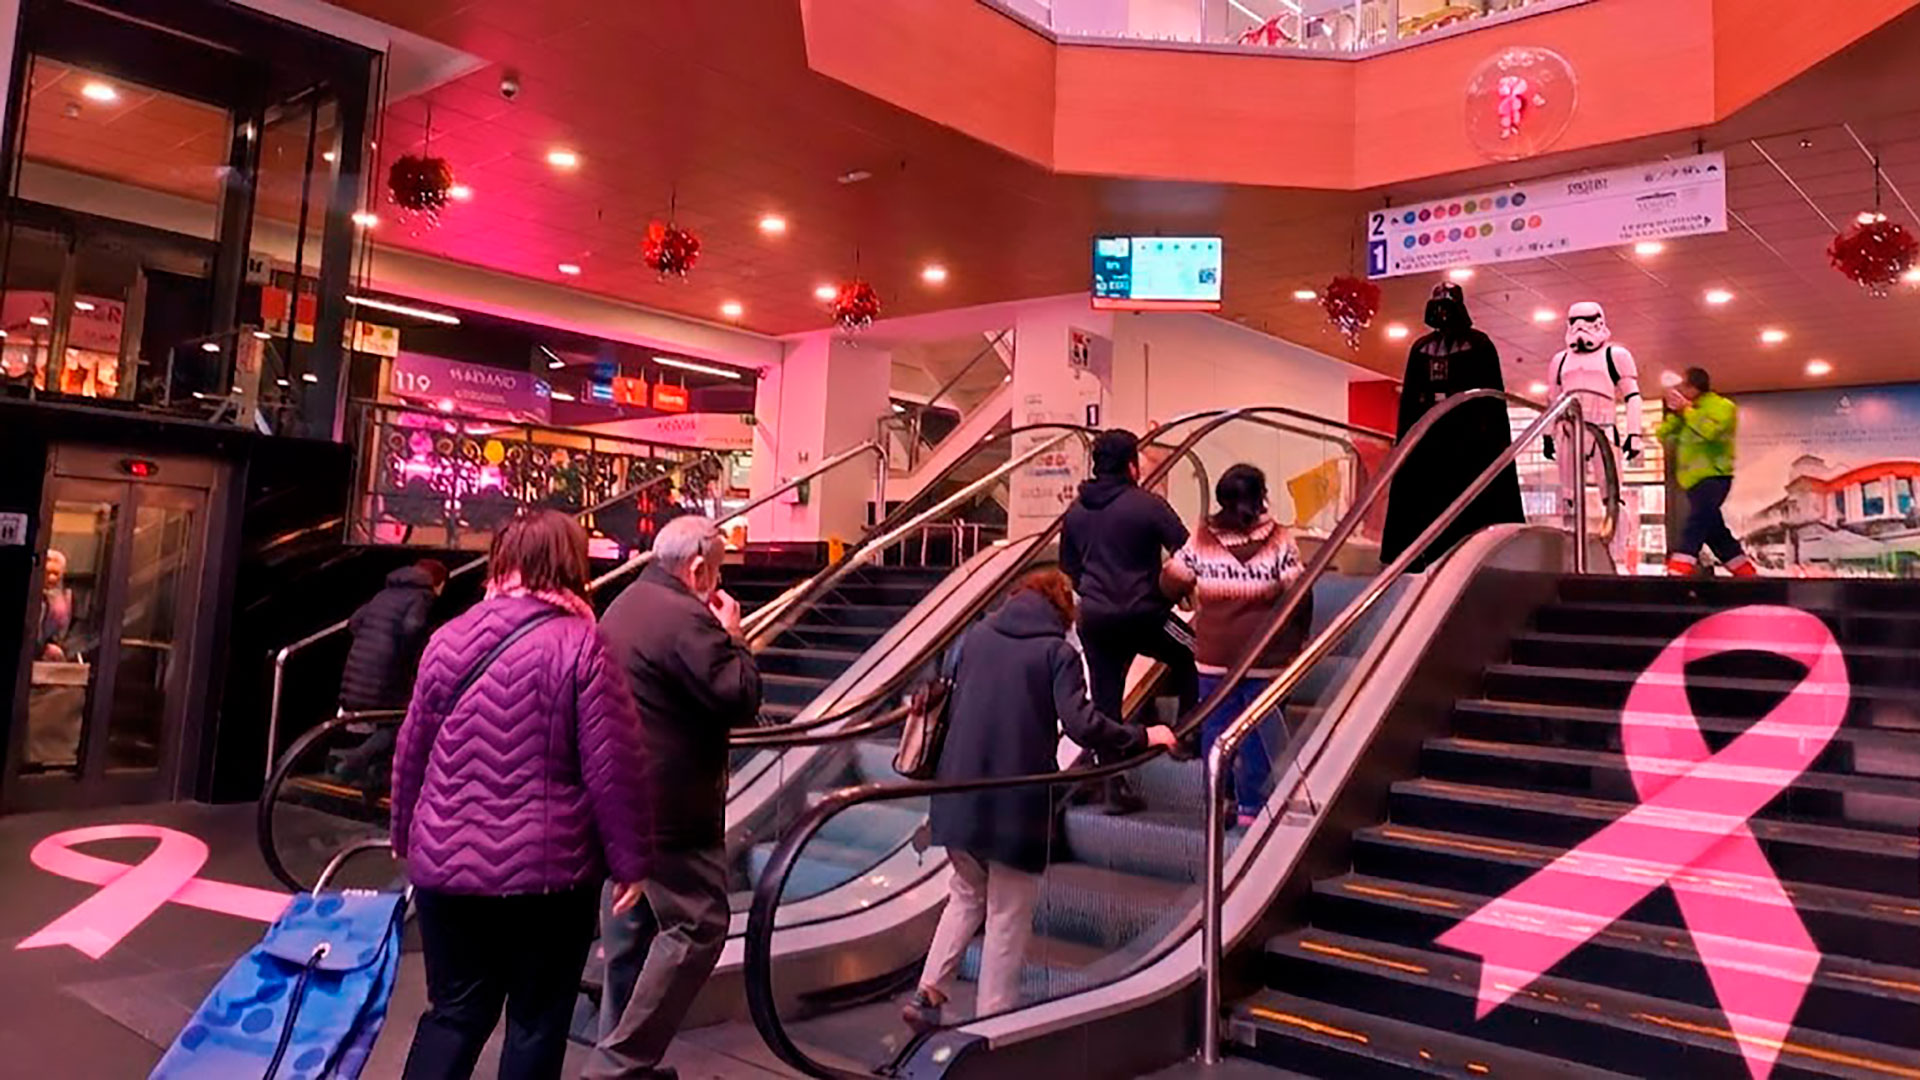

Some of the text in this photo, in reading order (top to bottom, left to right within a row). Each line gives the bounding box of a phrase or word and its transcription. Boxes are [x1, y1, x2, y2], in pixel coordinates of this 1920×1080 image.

[1372, 213, 1385, 236] 2
[1373, 244, 1385, 271] 1
[396, 370, 431, 392] 119
